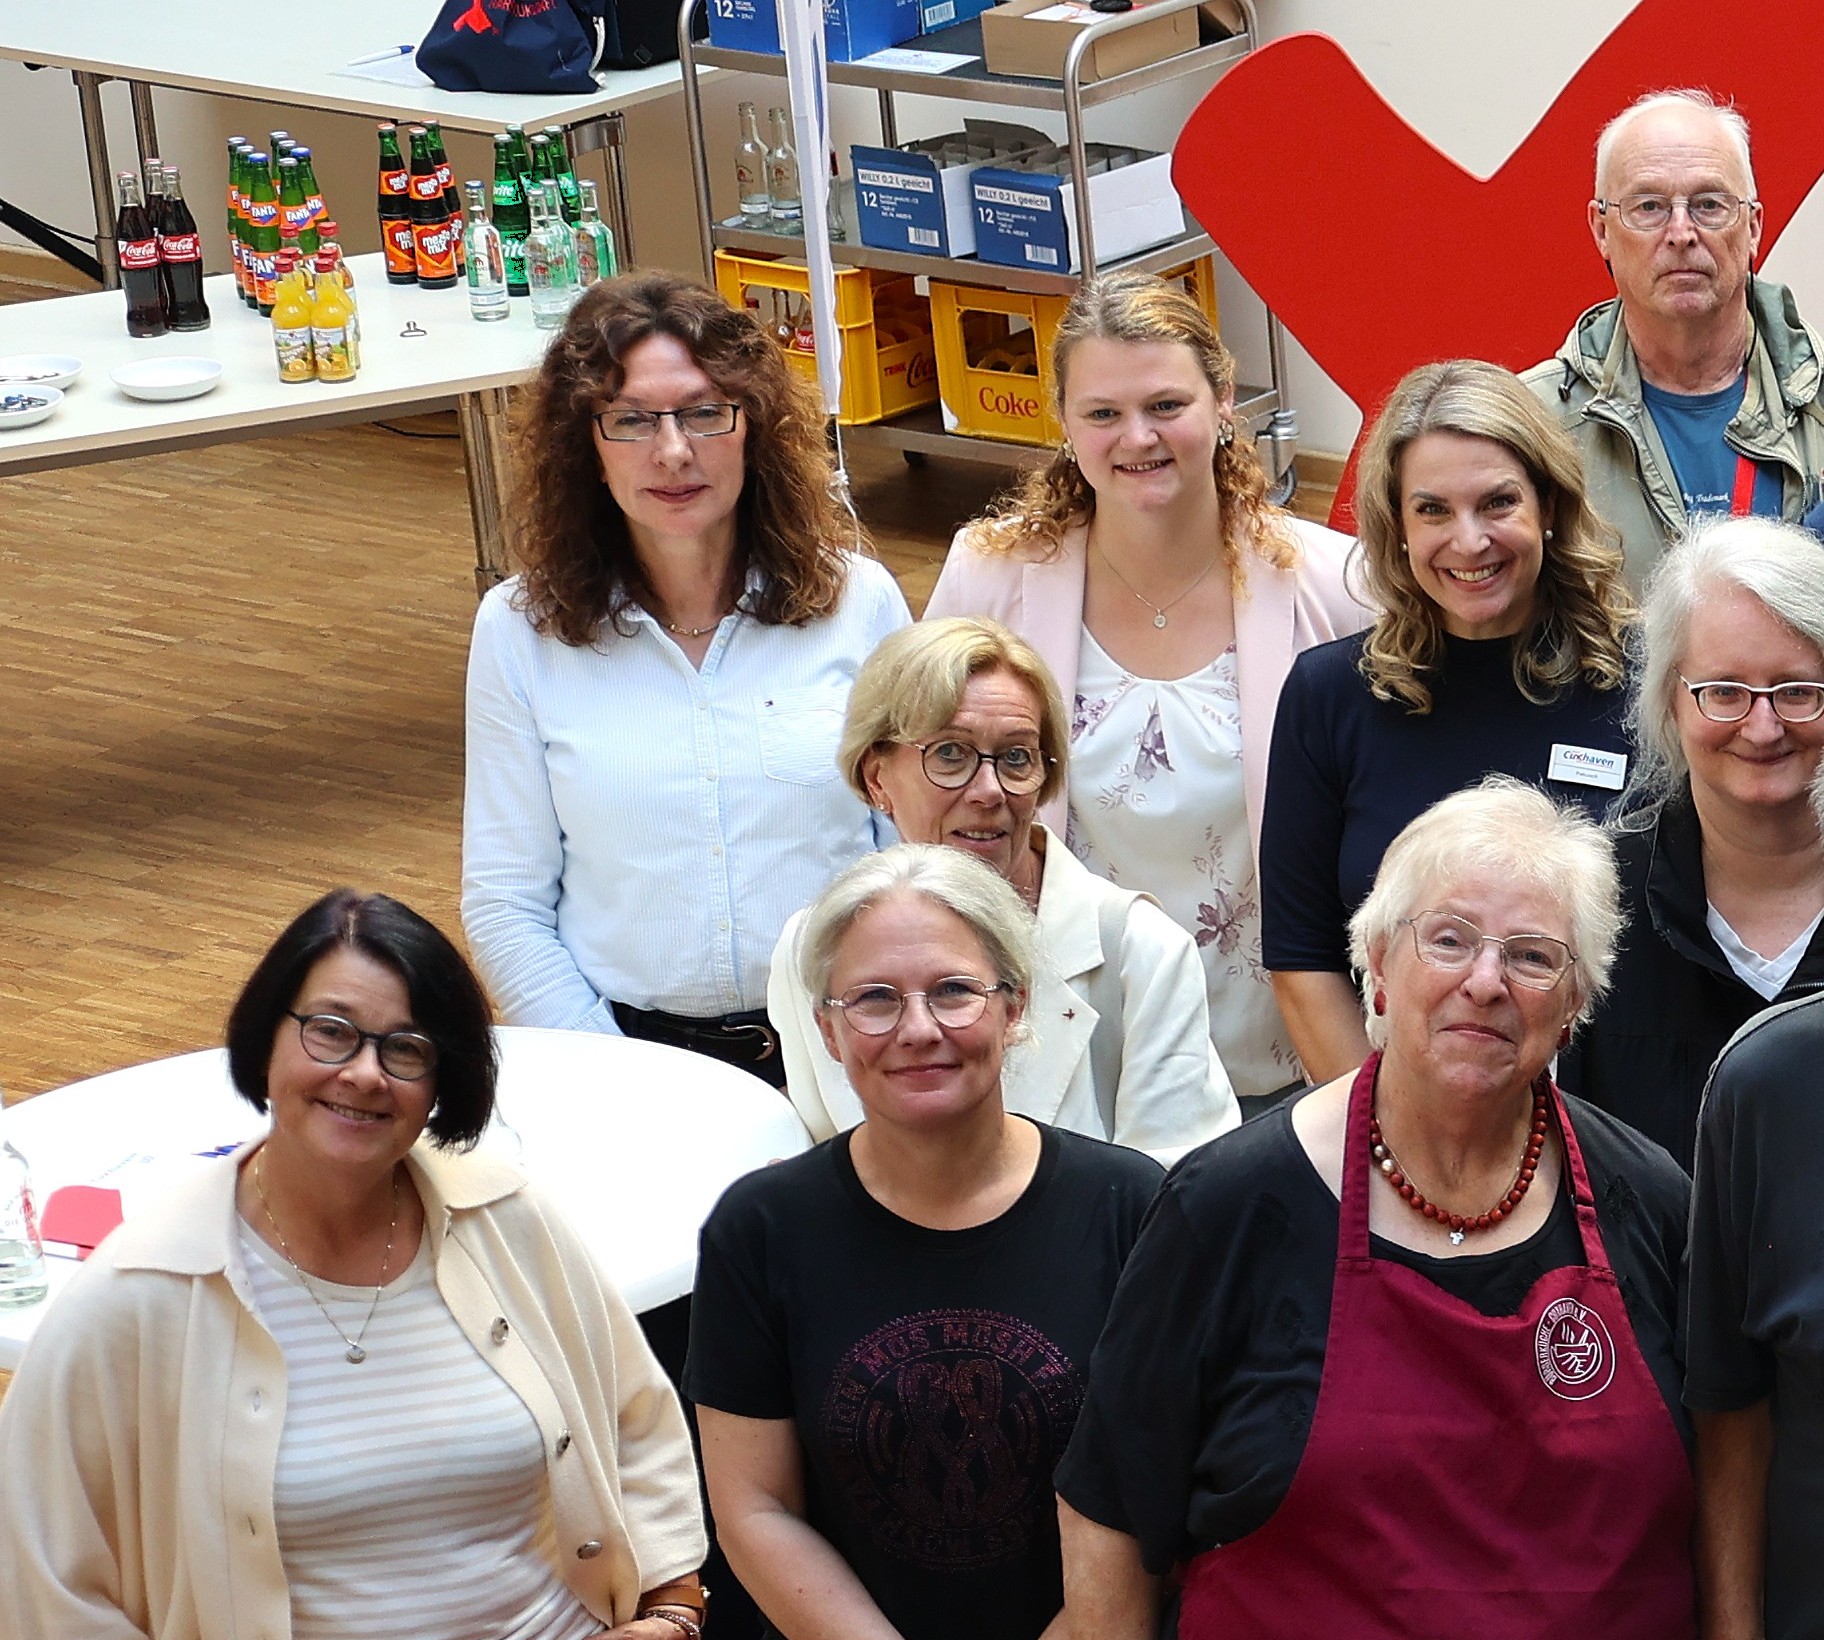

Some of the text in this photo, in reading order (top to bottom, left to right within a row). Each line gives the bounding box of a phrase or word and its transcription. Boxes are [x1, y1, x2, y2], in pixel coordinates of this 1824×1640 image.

[862, 191, 878, 208] 12
[251, 204, 277, 218] FANTA
[978, 207, 995, 224] 12
[979, 386, 1040, 418] Coke
[1563, 750, 1615, 768] Cuxhaven
